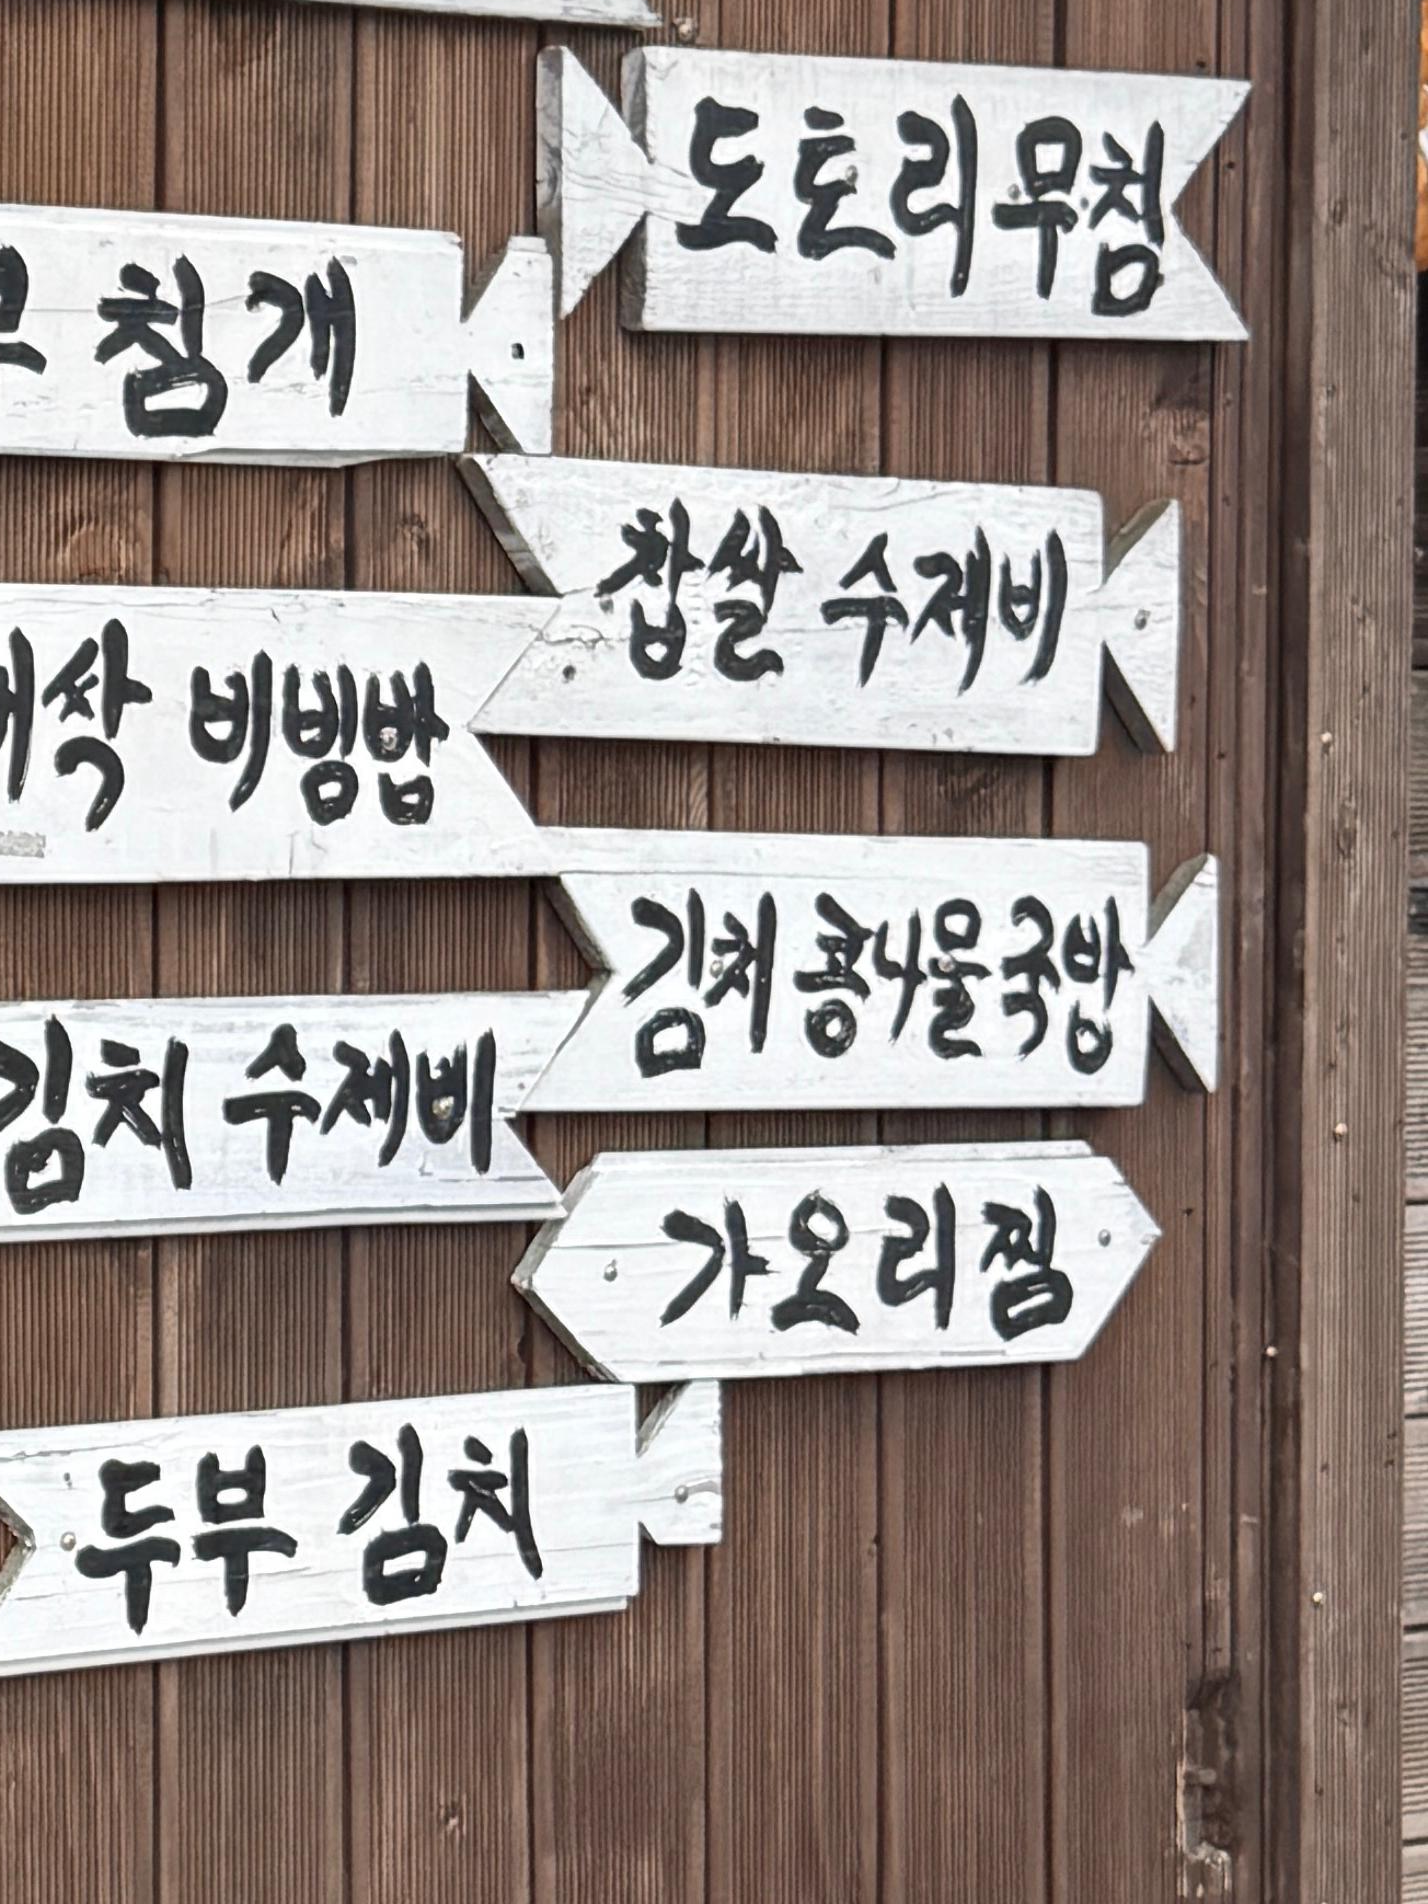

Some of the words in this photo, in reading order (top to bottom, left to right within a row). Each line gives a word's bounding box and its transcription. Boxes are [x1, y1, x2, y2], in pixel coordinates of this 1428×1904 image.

[675, 92, 1165, 317] 도토리무침
[595, 497, 804, 683] 찹쌀
[819, 525, 1069, 697] 수제비
[622, 888, 777, 1079] 김치
[223, 1022, 498, 1186] 수제비
[659, 1182, 1075, 1341] 가오리찜
[74, 1444, 299, 1637] 두부
[337, 1421, 544, 1607] 김치
